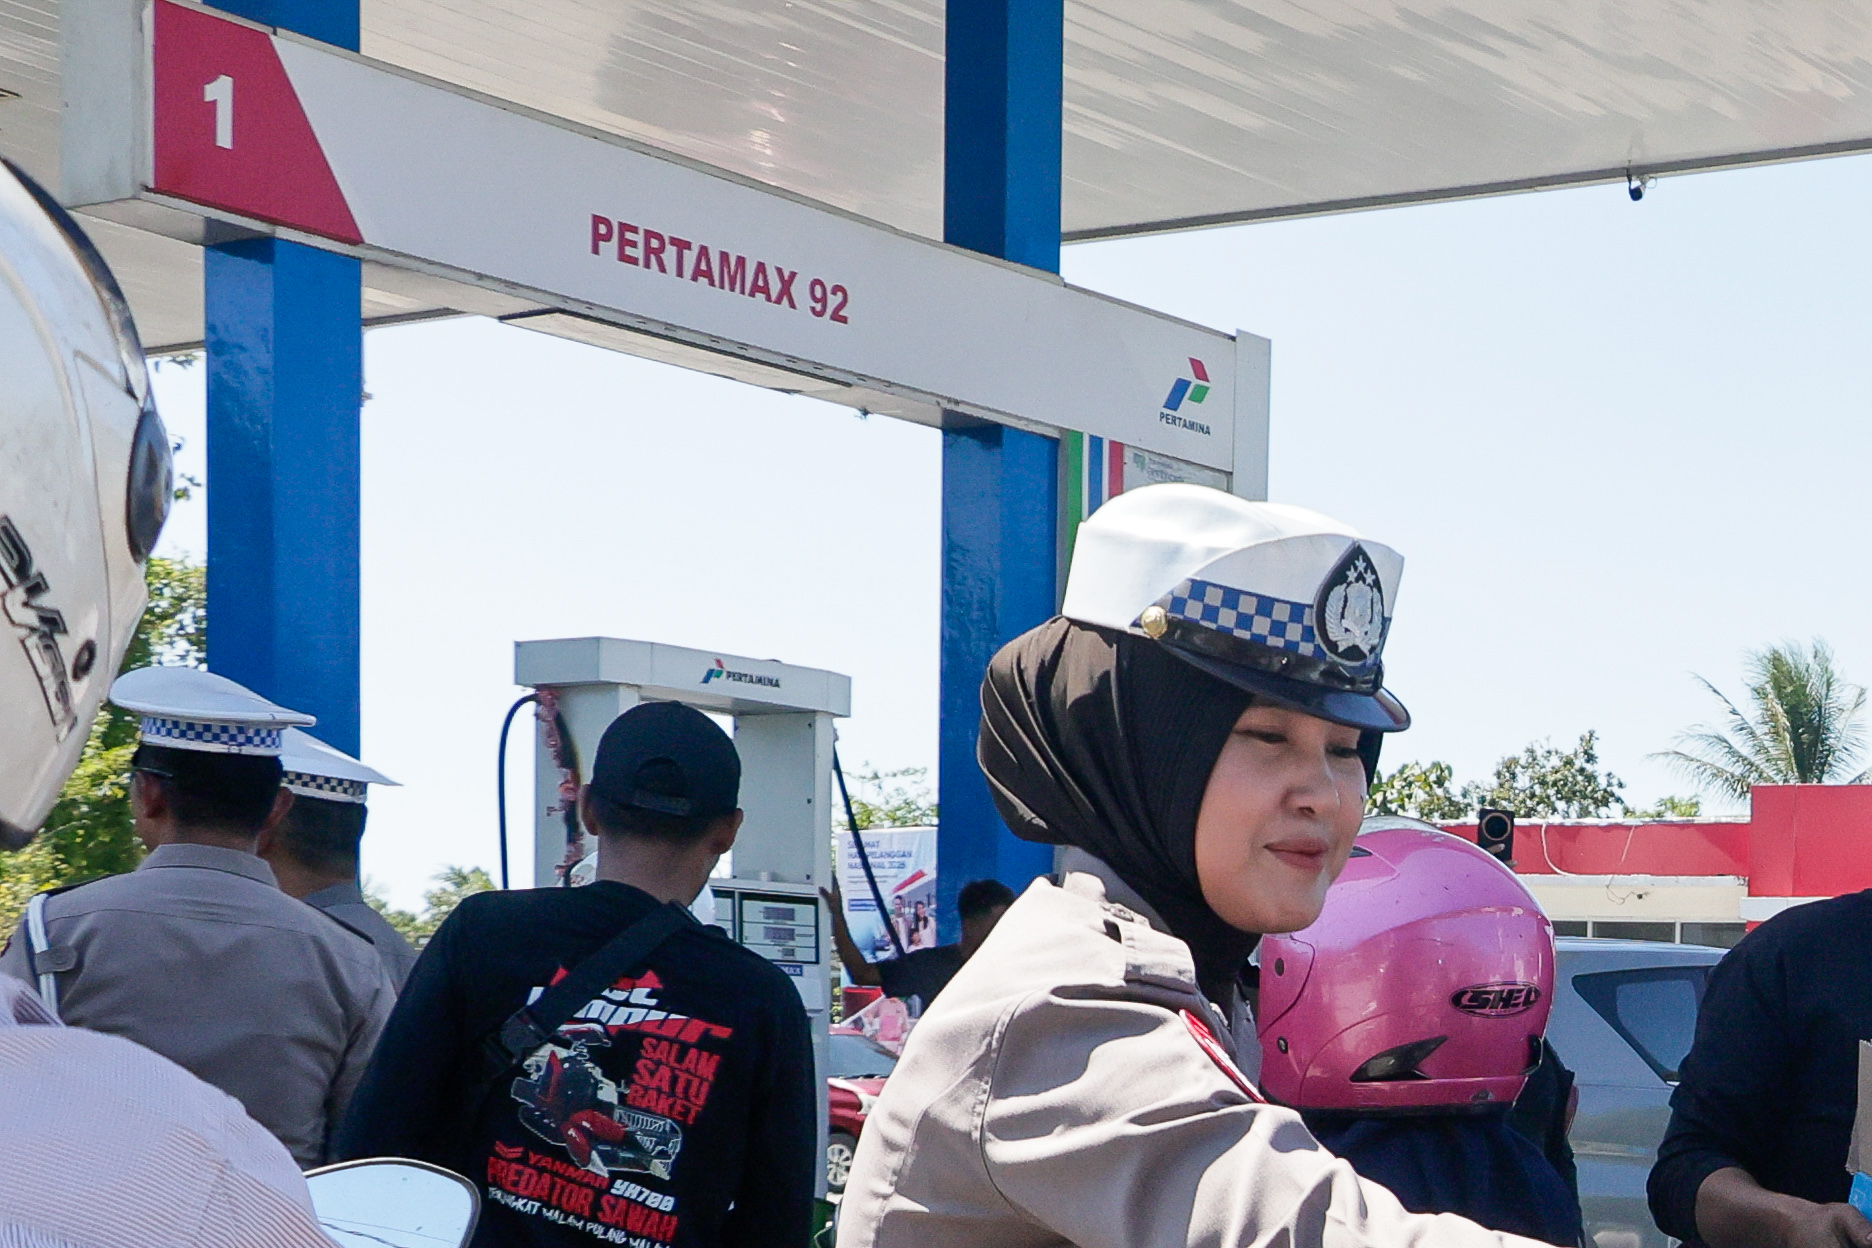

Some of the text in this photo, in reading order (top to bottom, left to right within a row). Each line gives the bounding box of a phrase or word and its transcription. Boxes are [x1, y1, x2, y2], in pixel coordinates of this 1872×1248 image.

[203, 74, 235, 150] 1
[591, 213, 849, 325] PERTAMAX 92
[1159, 411, 1211, 436] PERTAMINA
[726, 671, 781, 688] PERTAMINA
[641, 1037, 721, 1076] SALAM
[633, 1058, 713, 1105] SATU
[488, 1156, 596, 1219] PREDATOR
[528, 1151, 611, 1189] YANMAR
[542, 1206, 585, 1231] MALAM
[585, 1221, 628, 1244] PULANG
[596, 1195, 679, 1242] SAWAH
